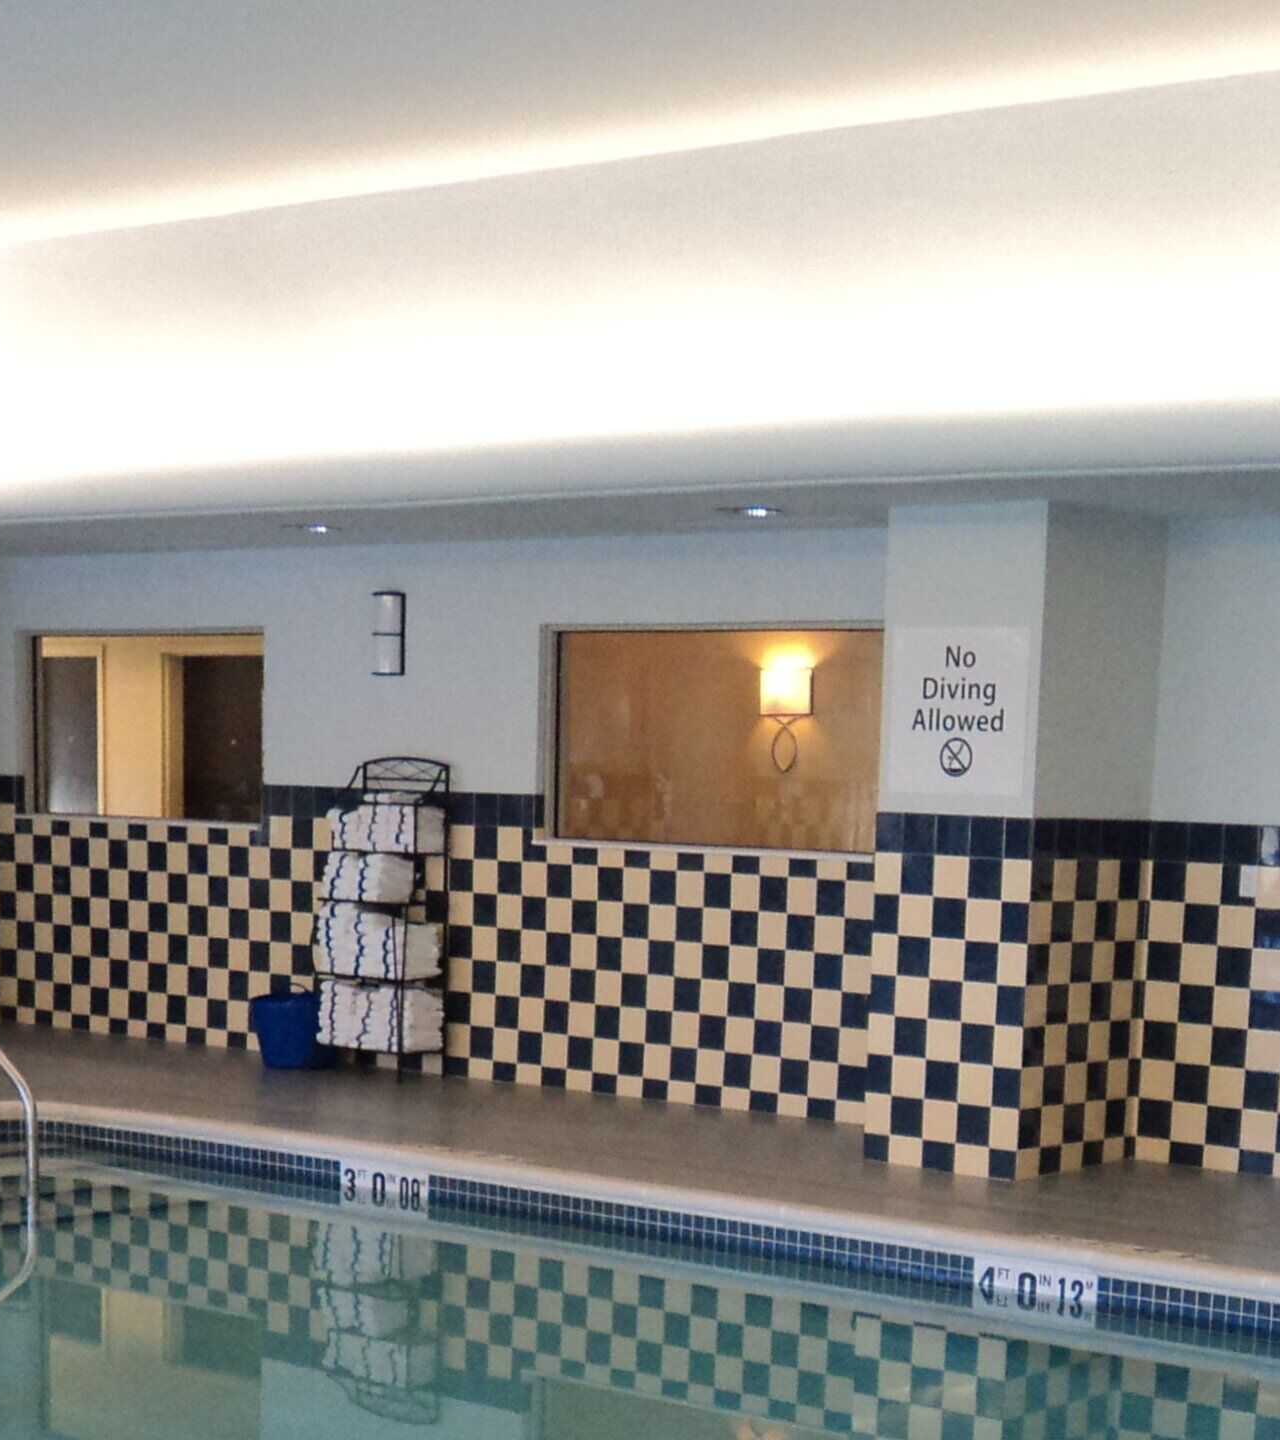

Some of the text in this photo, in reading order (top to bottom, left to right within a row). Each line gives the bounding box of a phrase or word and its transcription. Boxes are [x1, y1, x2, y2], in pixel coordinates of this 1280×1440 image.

[945, 645, 976, 668] No
[922, 677, 996, 706] Diving
[911, 708, 1005, 732] Allowed
